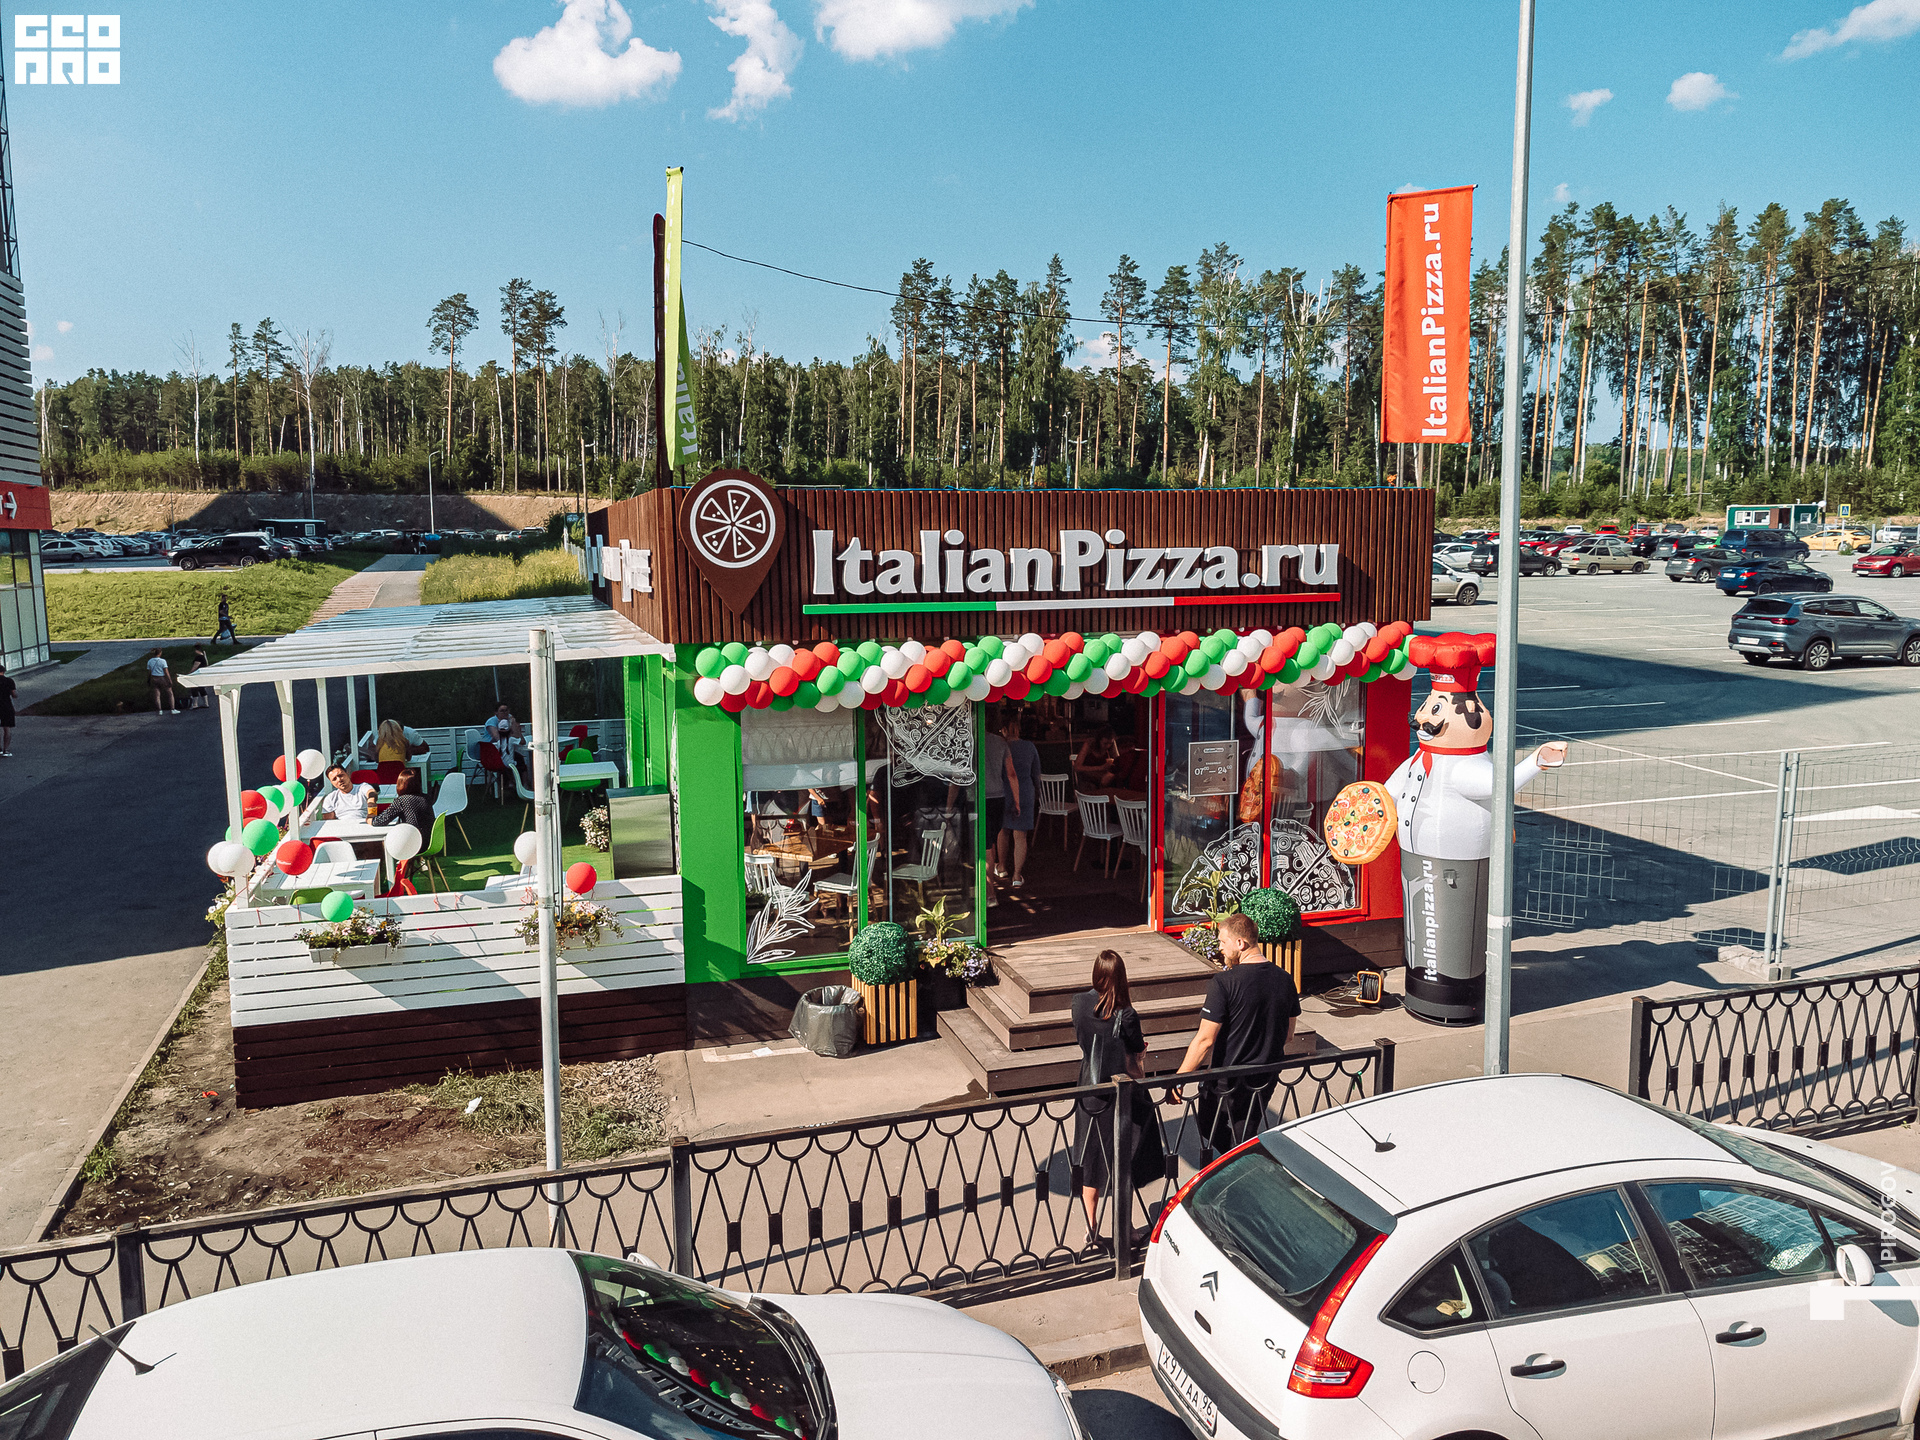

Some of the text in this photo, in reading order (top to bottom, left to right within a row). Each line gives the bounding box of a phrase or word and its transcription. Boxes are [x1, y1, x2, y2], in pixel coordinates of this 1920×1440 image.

[1421, 203, 1448, 437] ItalianPizza.ru
[812, 528, 1339, 595] ItalianPizza.ru
[1422, 860, 1439, 982] italianpizza.ru
[1264, 1338, 1287, 1359] C4
